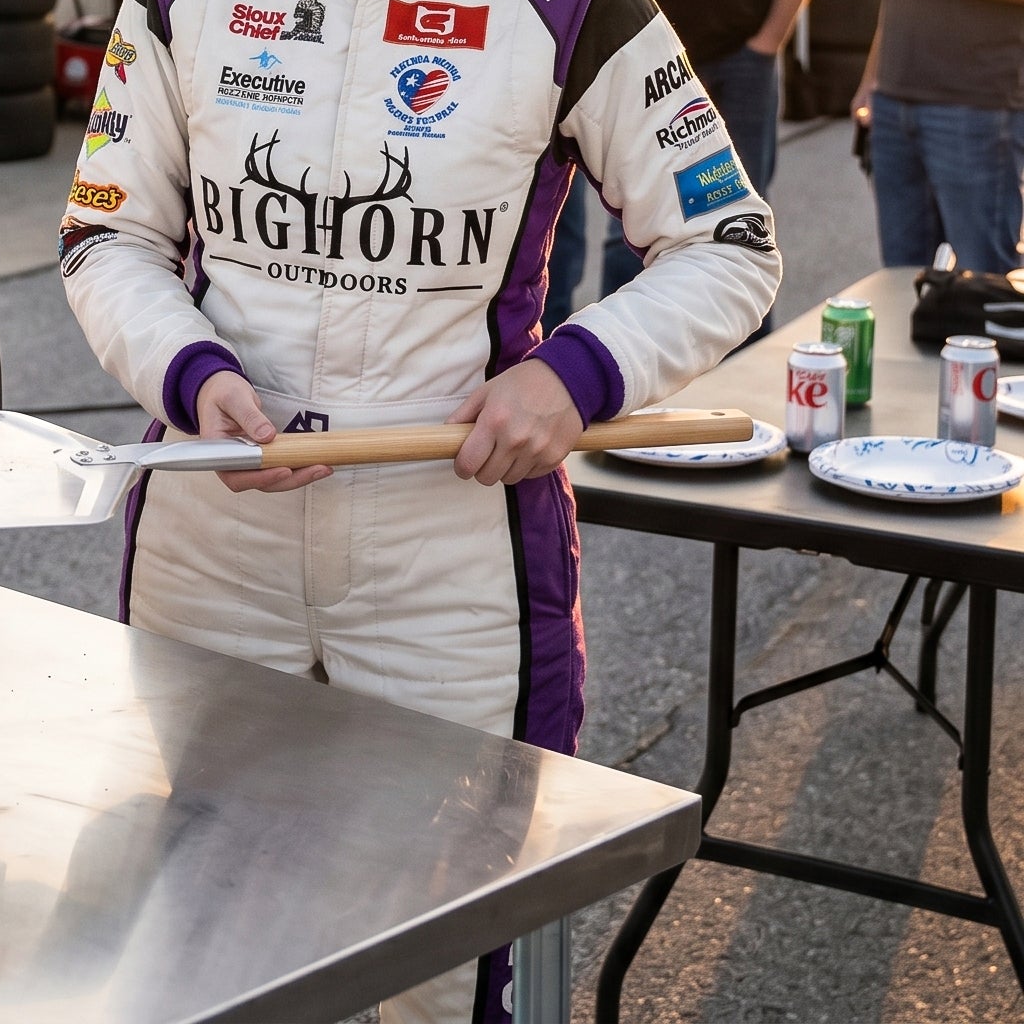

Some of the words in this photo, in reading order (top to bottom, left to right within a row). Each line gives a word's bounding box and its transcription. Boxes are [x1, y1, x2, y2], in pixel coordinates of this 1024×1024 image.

[232, 3, 288, 26] Sioux
[228, 19, 281, 41] Chief
[219, 65, 307, 95] Executive
[200, 174, 498, 268] BIGHORN
